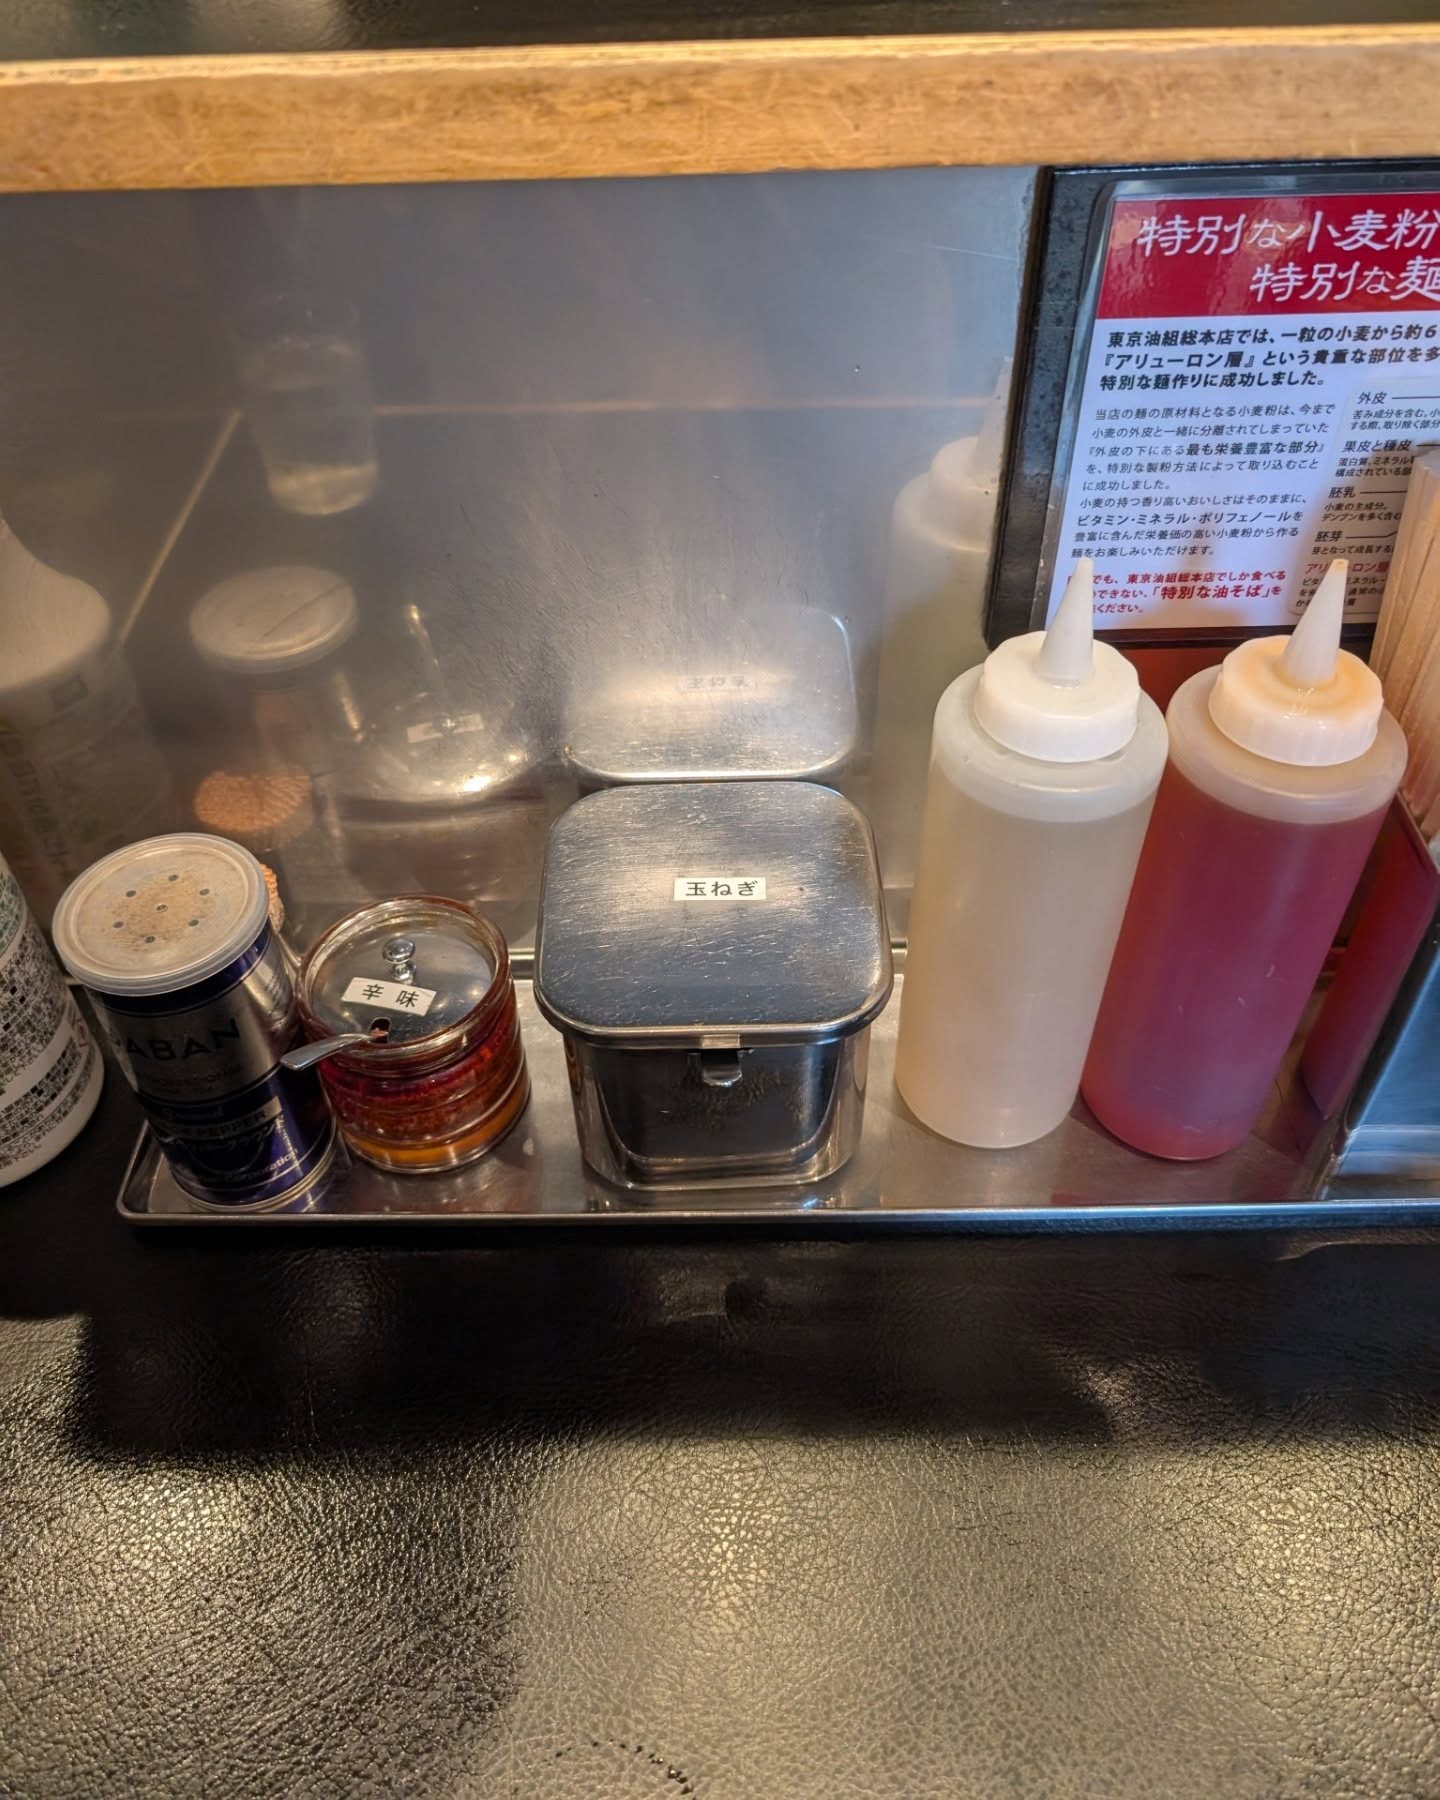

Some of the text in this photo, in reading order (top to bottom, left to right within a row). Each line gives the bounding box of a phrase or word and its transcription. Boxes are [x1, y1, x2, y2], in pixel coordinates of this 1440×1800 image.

[1137, 208, 1440, 257] 特別な小麦粉
[1249, 255, 1440, 303] 特別な麺
[1100, 370, 1324, 391] 特別な麺作りに成功しました。
[1357, 391, 1387, 405] 外皮
[1095, 404, 1336, 420] 当店の麺の原材料となる小麦粉は、今まで
[1092, 422, 1329, 439] 小麦の外皮と一緒に分離されてしまっていた
[1342, 439, 1412, 453] 果皮と種皮
[1086, 459, 1319, 474] を、特別な製粉方法によって取り込むこと
[1082, 480, 1170, 491] に成功しました。
[1328, 486, 1356, 498] 胚乳
[1080, 494, 1306, 509] 小麦の持つ香り高いおいしさはそのままに、
[1075, 527, 1299, 543] 豊富に含んだ栄養価の高い小麦粉から作る
[1315, 530, 1342, 542] 胚芽
[1071, 545, 1214, 558] 麺をお楽しみいただけます。
[1312, 544, 1394, 555] 芽となって成長する
[1067, 570, 1287, 585] でも、東京油組総本店でしか食べる
[1093, 604, 1143, 614] ください。
[685, 880, 758, 897] 玉ねぎ
[362, 983, 420, 1008] 辛味
